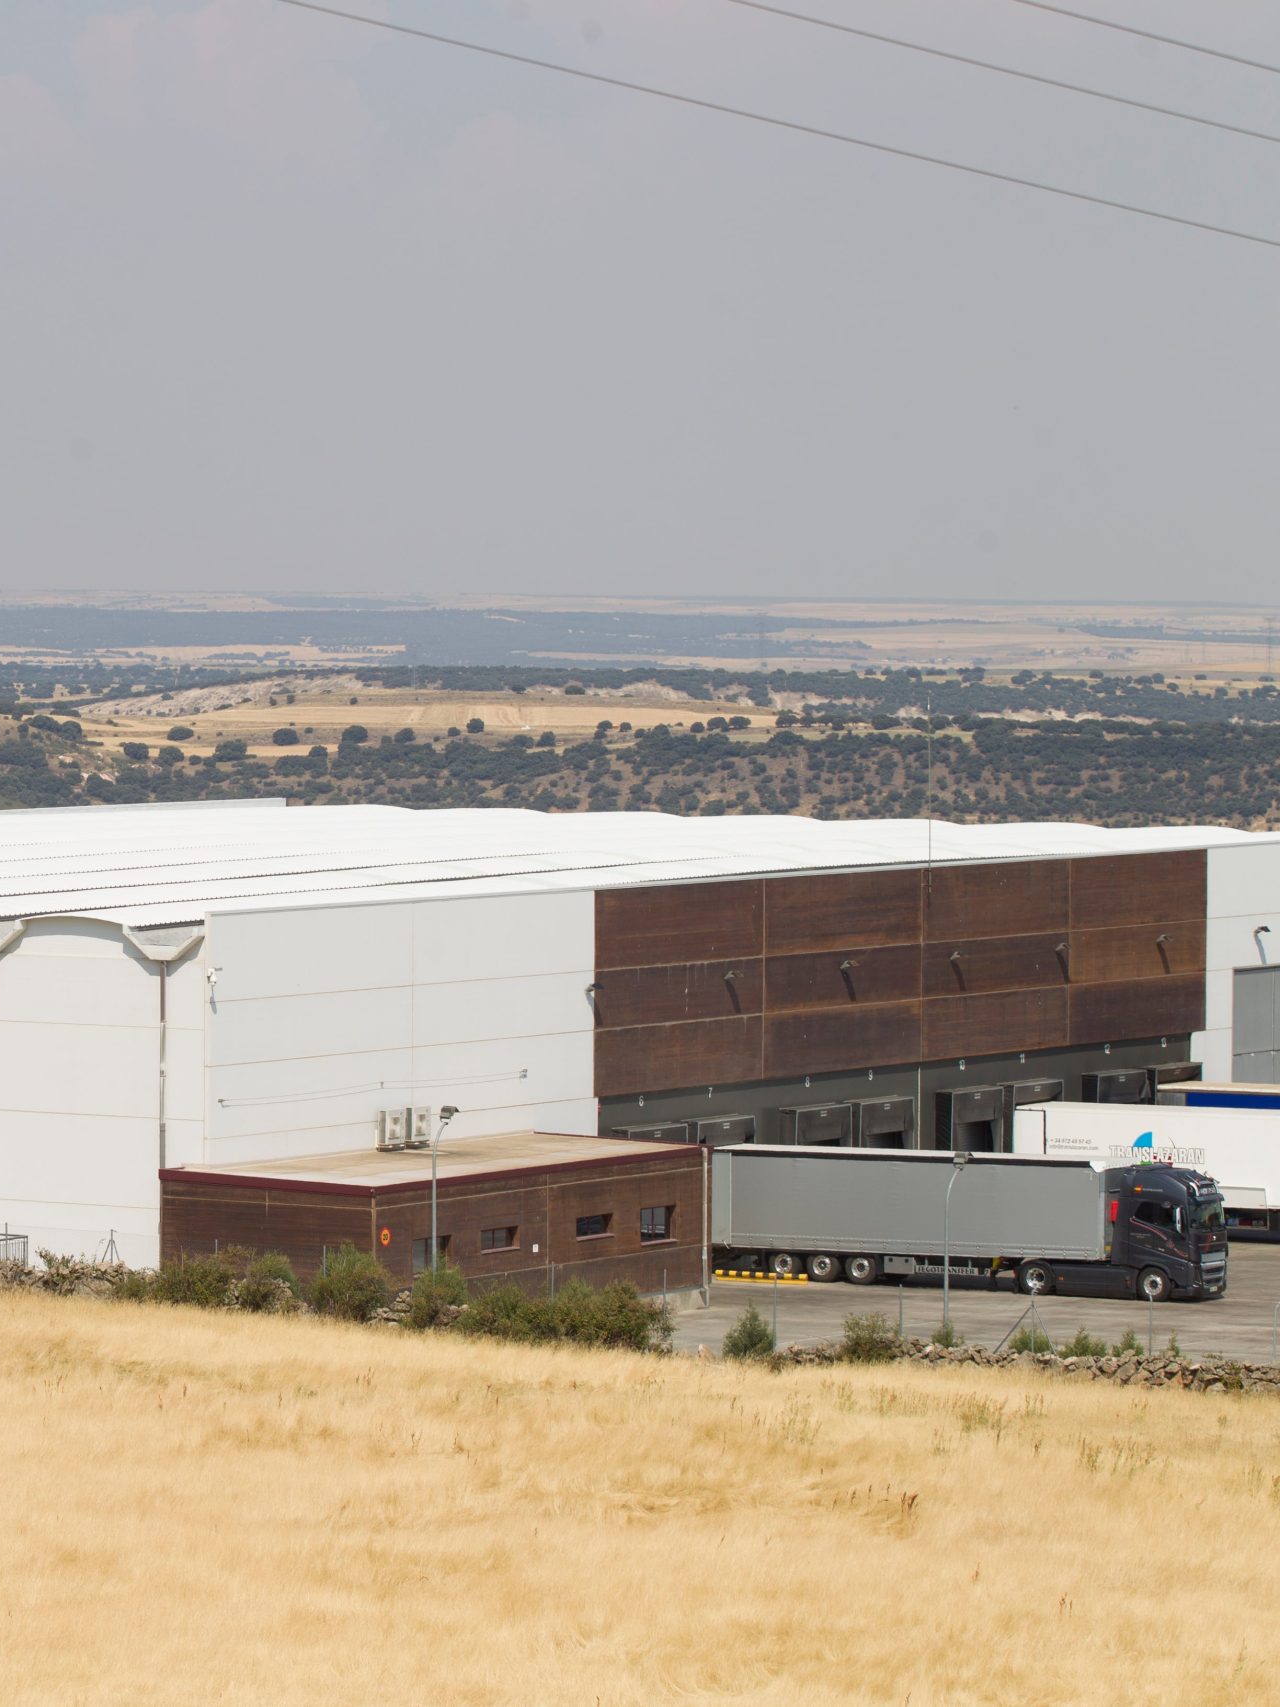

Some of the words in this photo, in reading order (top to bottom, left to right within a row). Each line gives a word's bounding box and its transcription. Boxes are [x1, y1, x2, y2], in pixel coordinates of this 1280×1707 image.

[1019, 1053, 1025, 1064] 11
[867, 1070, 873, 1081] 9
[805, 1076, 810, 1088] 8
[708, 1087, 713, 1099] 7
[638, 1095, 644, 1107] 6
[1109, 1144, 1205, 1164] TRANSLAZARAN
